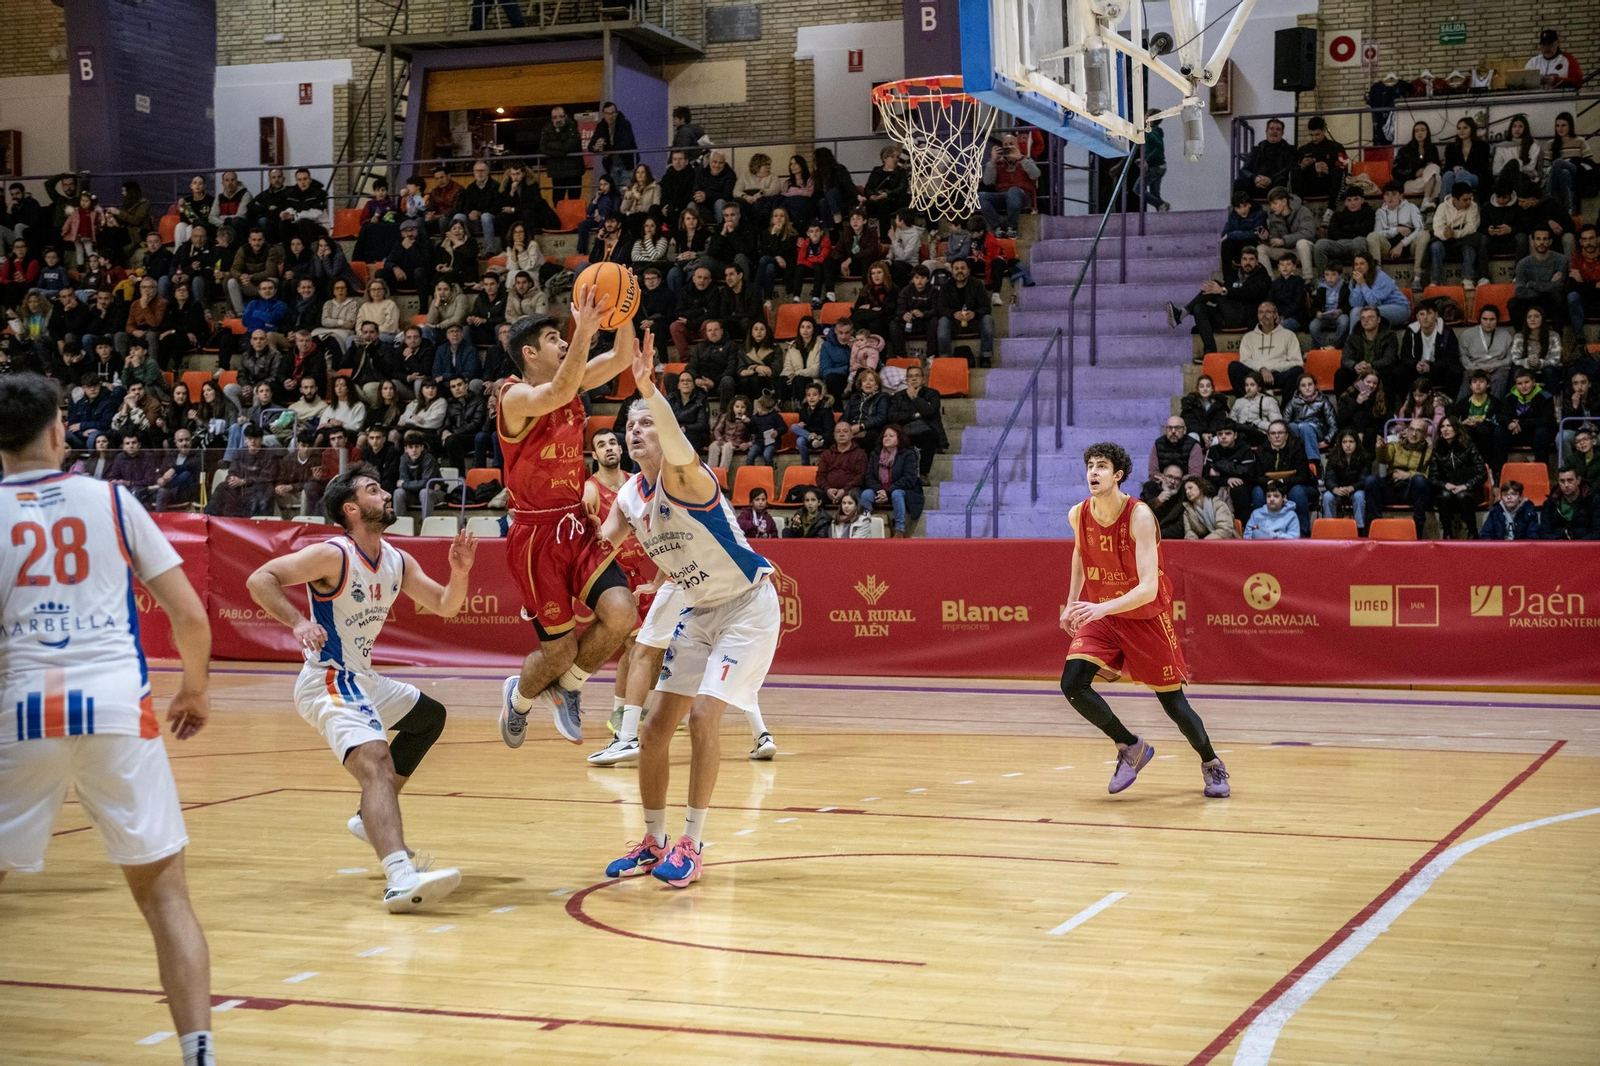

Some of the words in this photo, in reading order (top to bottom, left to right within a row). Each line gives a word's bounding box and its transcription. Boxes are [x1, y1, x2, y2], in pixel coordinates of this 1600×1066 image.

[921, 6, 937, 31] B
[1441, 24, 1466, 32] SALIDA
[79, 58, 94, 81] B
[619, 272, 636, 313] Wilson
[643, 513, 651, 533] 1
[1100, 534, 1114, 552] 21
[11, 516, 90, 587] 28
[1101, 567, 1128, 581] Jaén
[369, 583, 382, 602] 14
[1508, 584, 1585, 616] Jaén
[219, 608, 253, 619] PABLO
[829, 609, 863, 622] CAJA
[867, 609, 916, 622] RURAL
[941, 598, 1030, 622] Blanca
[480, 615, 520, 625] INTERIOR
[942, 622, 990, 631] impresores
[1206, 614, 1249, 626] PABLO
[1252, 614, 1320, 627] CARVAJAL
[1509, 616, 1558, 628] PARAÍSO
[854, 623, 889, 637] JAÉN
[721, 664, 730, 682] 1
[1162, 665, 1174, 677] 21
